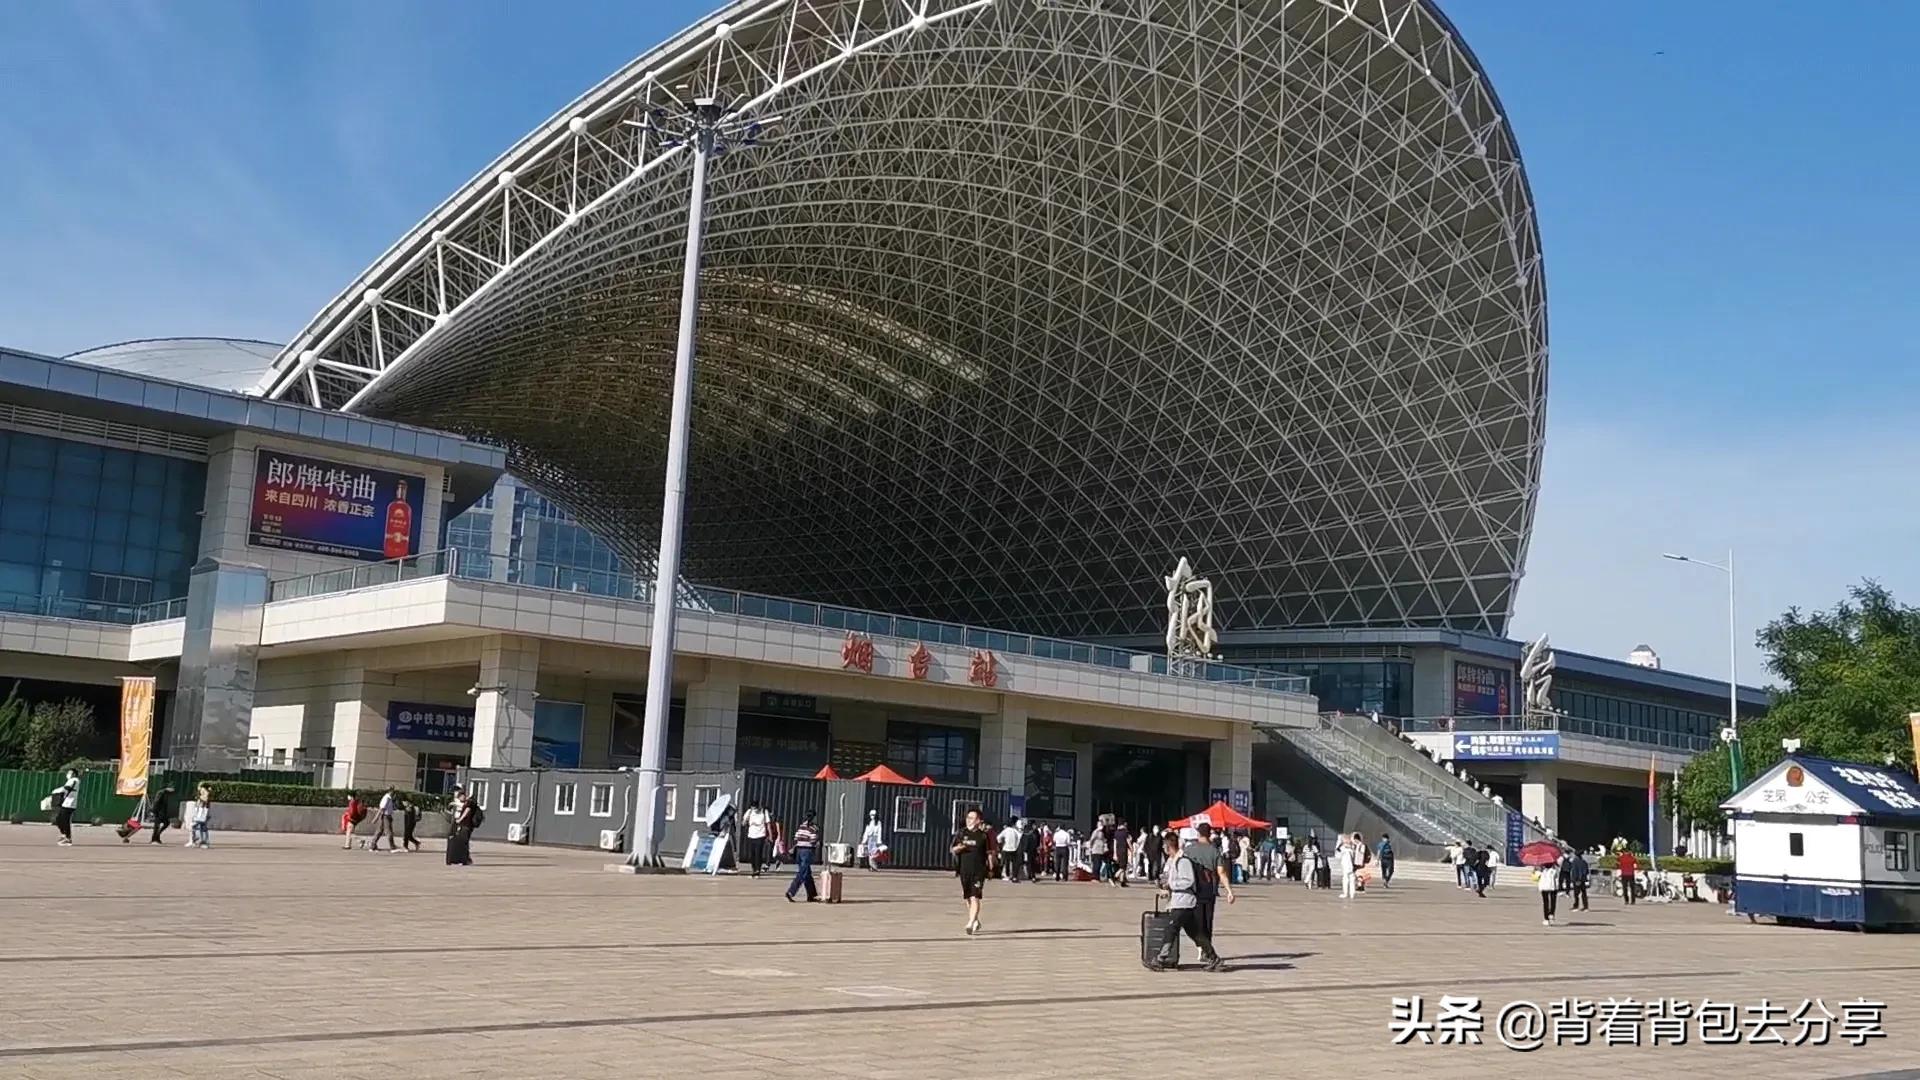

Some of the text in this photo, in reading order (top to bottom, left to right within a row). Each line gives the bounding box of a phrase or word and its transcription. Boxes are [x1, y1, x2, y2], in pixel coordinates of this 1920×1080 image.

[266, 457, 377, 501] 郎牌特曲
[264, 488, 375, 518] 来自四川 浓香正宗
[841, 629, 998, 688] 烟台站
[1804, 790, 1831, 804] 公安
